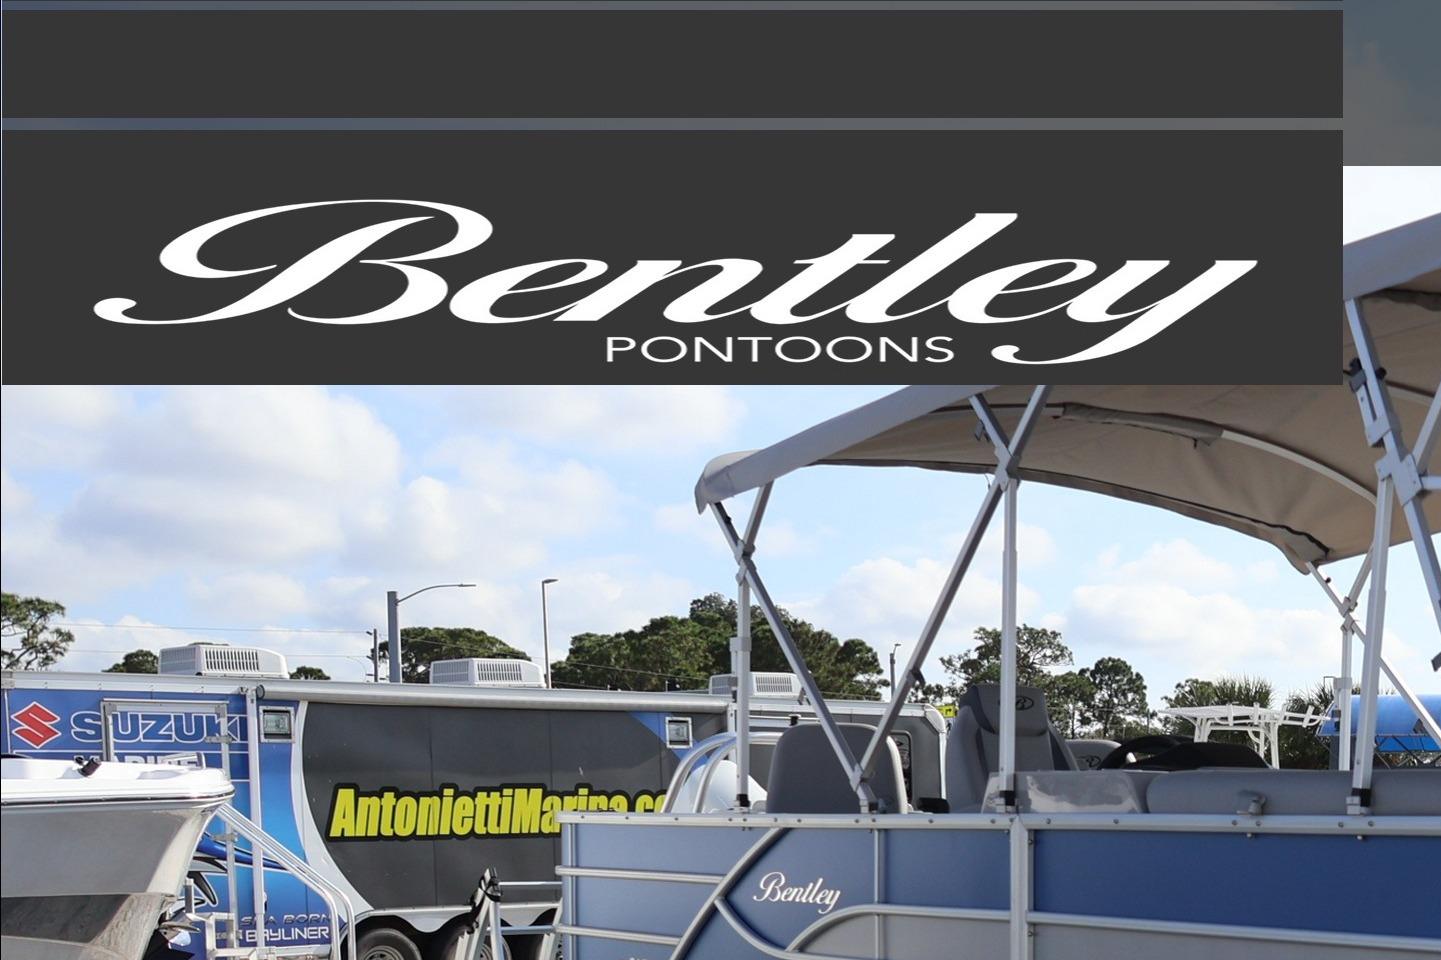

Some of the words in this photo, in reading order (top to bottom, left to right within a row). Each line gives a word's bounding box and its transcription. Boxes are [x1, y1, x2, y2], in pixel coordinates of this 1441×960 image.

[70, 710, 249, 744] SUZUKI
[752, 871, 841, 915] Bentley
[240, 915, 276, 926] SA
